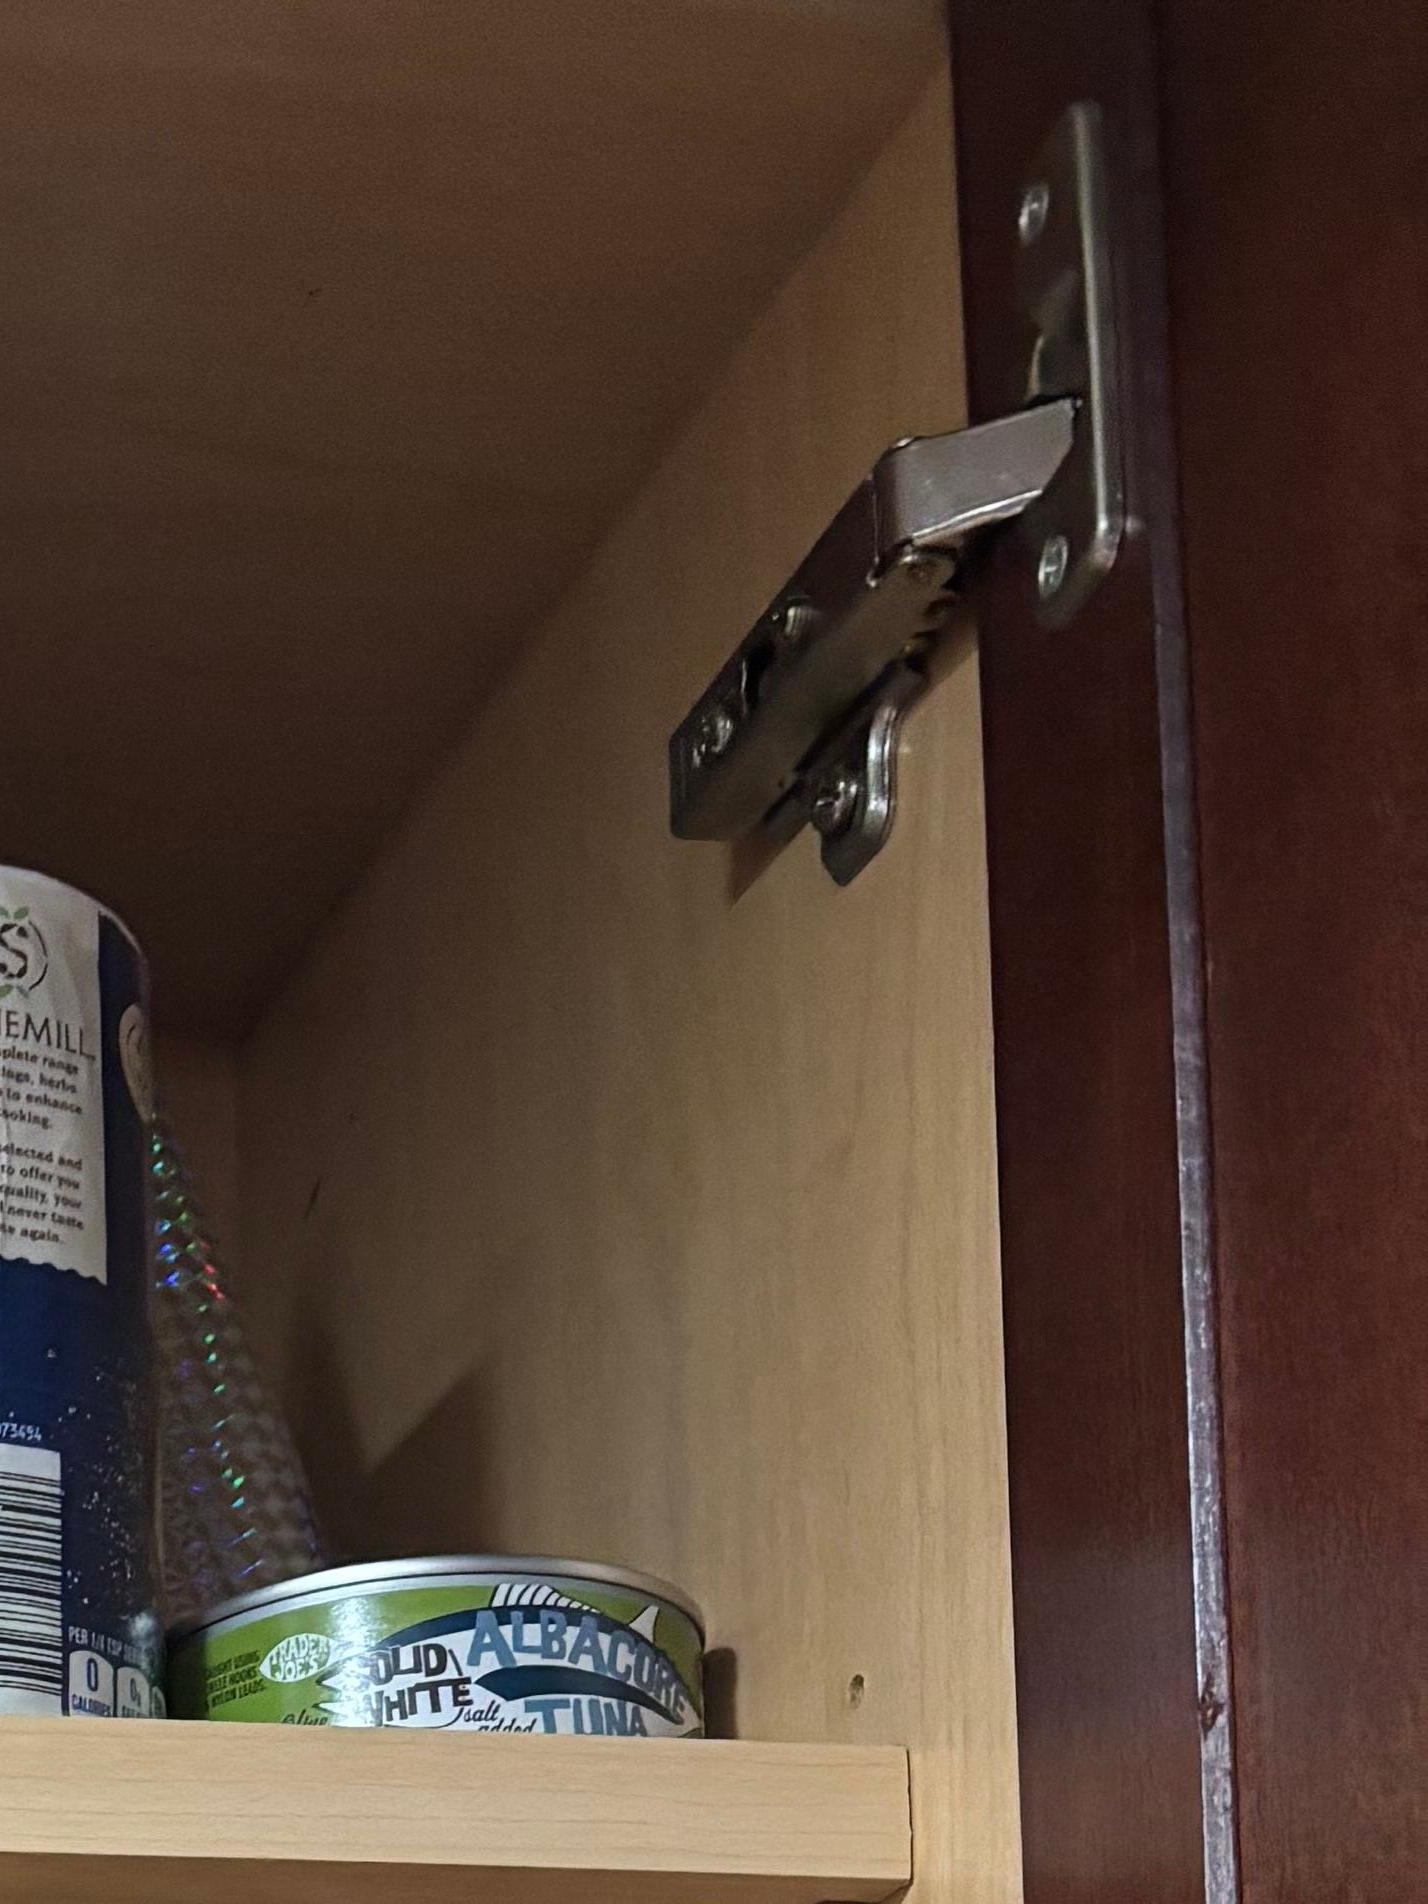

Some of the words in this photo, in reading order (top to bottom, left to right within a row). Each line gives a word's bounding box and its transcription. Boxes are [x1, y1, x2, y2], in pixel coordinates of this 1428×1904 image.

[269, 1634, 330, 1666] TRADER
[467, 1609, 690, 1717] ALBACORE
[363, 1676, 473, 1727] WHITE
[526, 1698, 650, 1737] TUNA
